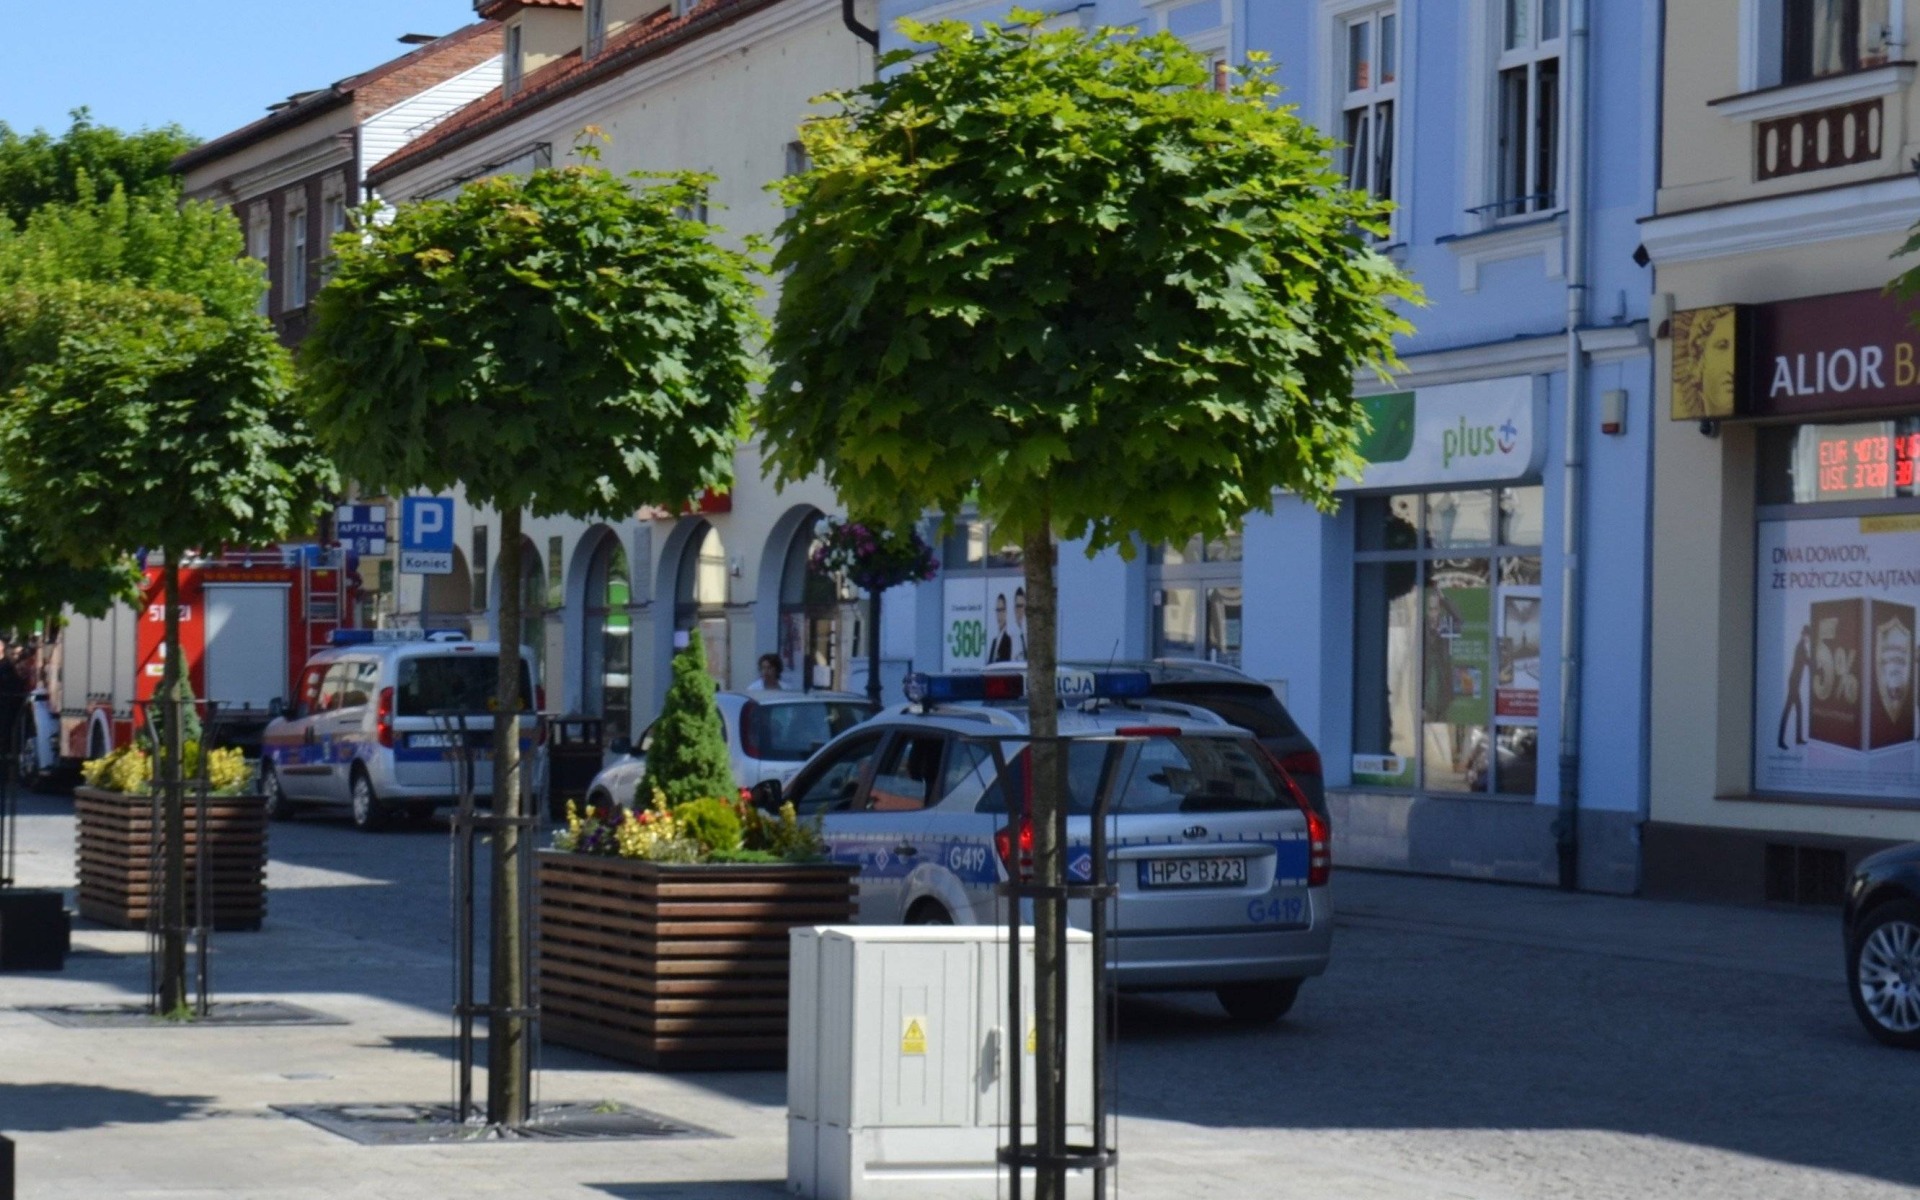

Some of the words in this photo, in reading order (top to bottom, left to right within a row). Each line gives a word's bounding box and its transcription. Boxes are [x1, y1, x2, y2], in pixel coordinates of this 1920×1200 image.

[1770, 345, 1885, 398] ALIOR
[1895, 342, 1920, 387] B
[1443, 416, 1496, 469] plus
[413, 502, 443, 544] P
[406, 556, 447, 569] Koniec
[1772, 546, 1803, 564] DWA
[950, 845, 986, 873] G419
[1151, 858, 1193, 883] HPG
[1198, 857, 1243, 881] B323
[1247, 897, 1302, 923] G419
